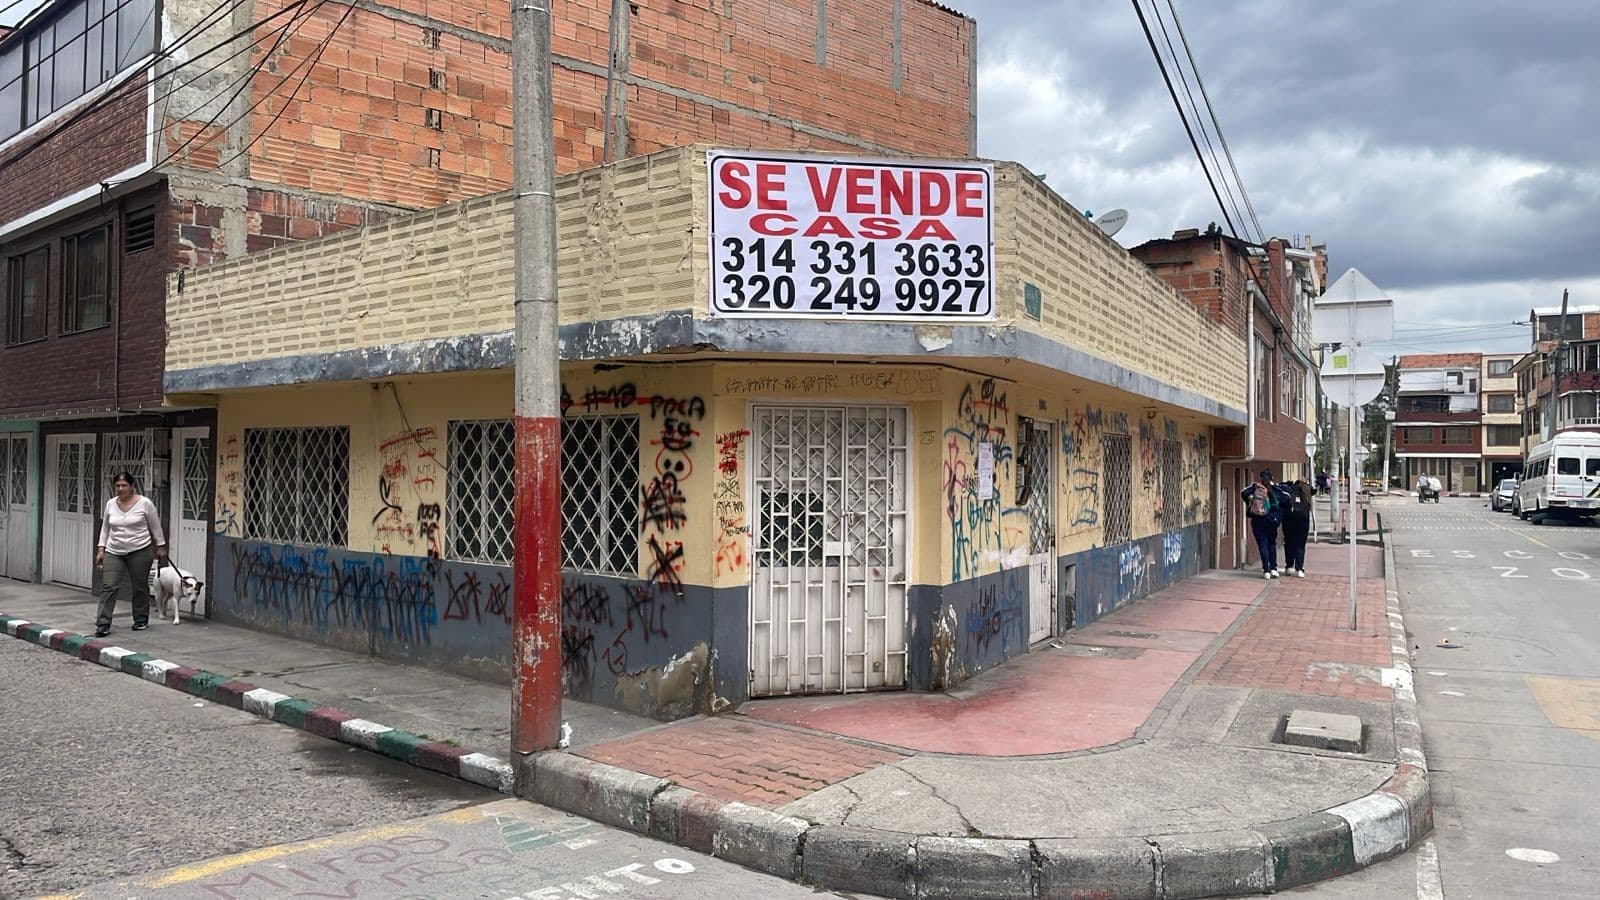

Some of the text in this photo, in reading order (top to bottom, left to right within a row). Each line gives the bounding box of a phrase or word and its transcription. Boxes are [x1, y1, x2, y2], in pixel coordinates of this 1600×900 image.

[718, 161, 984, 218] SE VENDE
[748, 213, 957, 241] CASA
[722, 237, 985, 278] 314 331 3633
[722, 274, 796, 310] 320
[810, 277, 881, 311] 249
[894, 278, 985, 313] 9927
